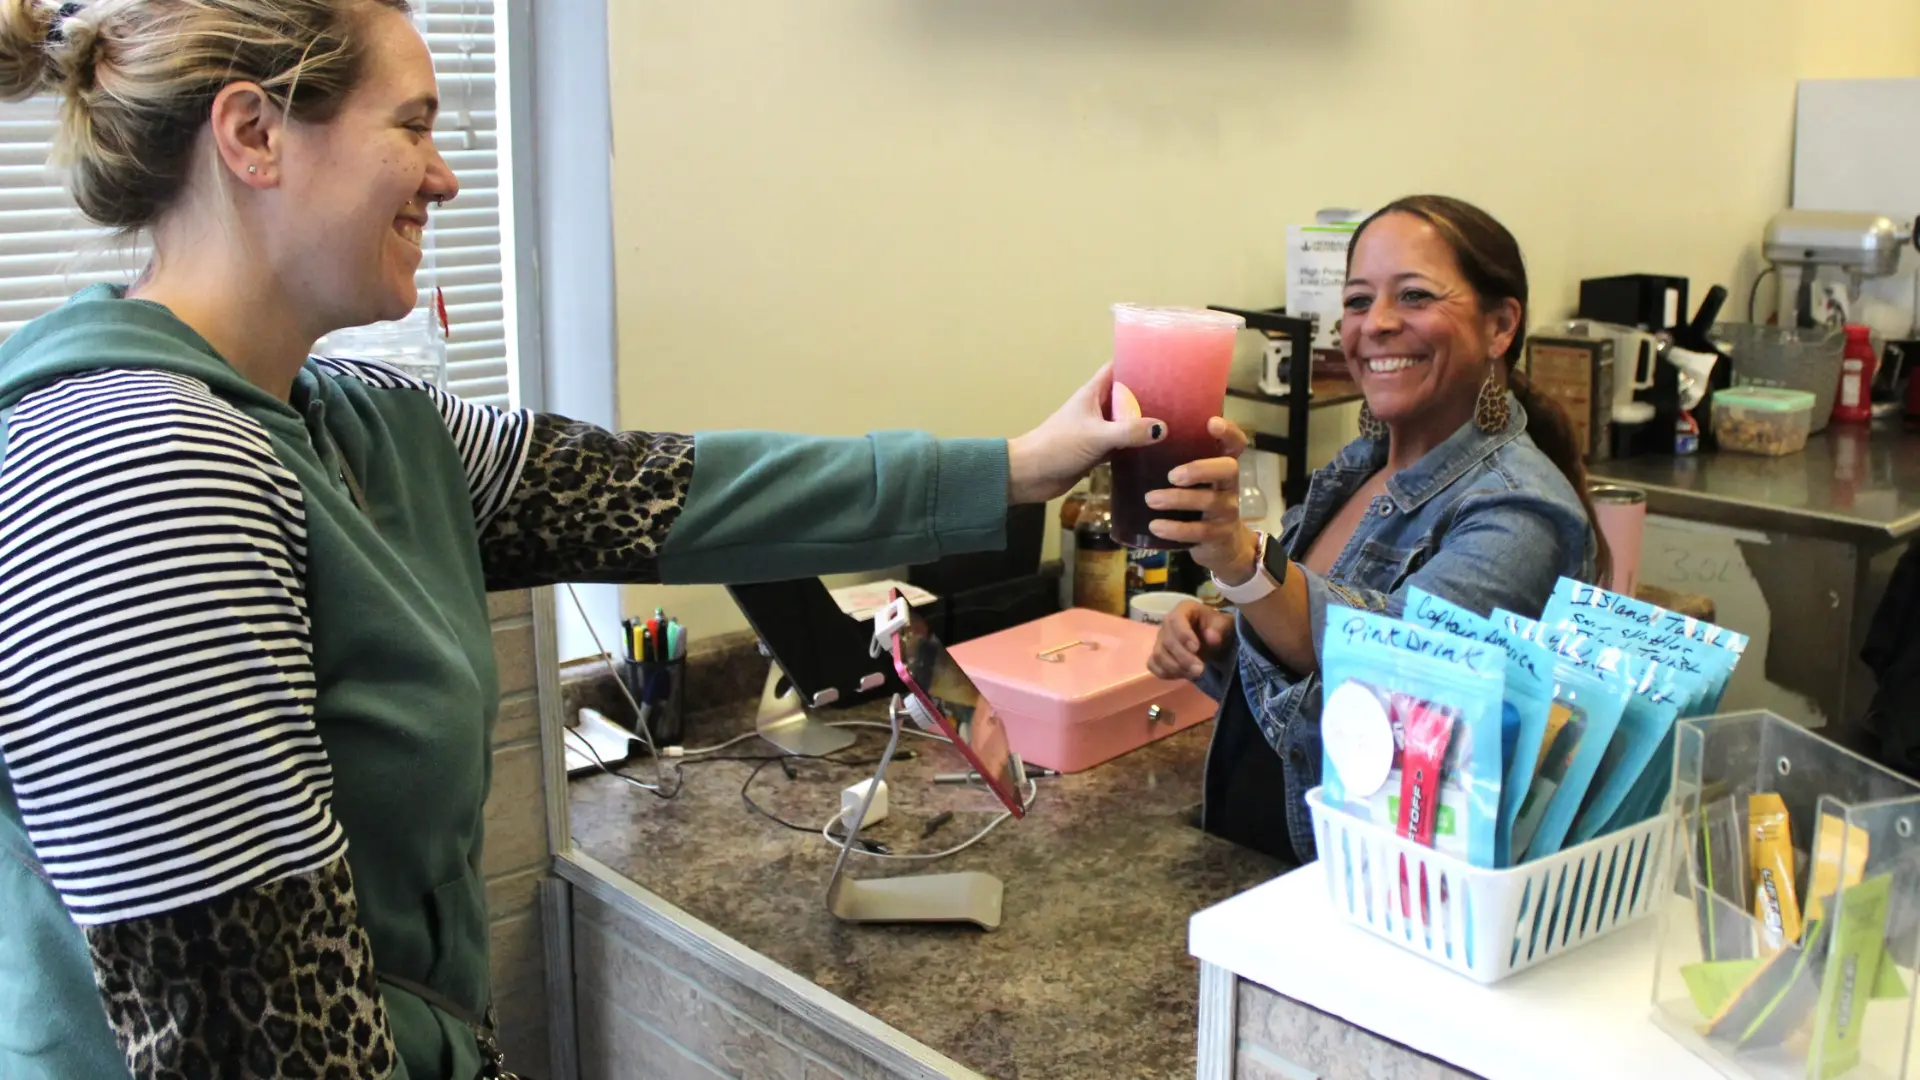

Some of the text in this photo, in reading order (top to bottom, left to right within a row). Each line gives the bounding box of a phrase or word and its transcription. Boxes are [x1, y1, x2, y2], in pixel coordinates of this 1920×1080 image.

[1416, 595, 1478, 641] Captain
[1342, 616, 1485, 674] Pink Drink
